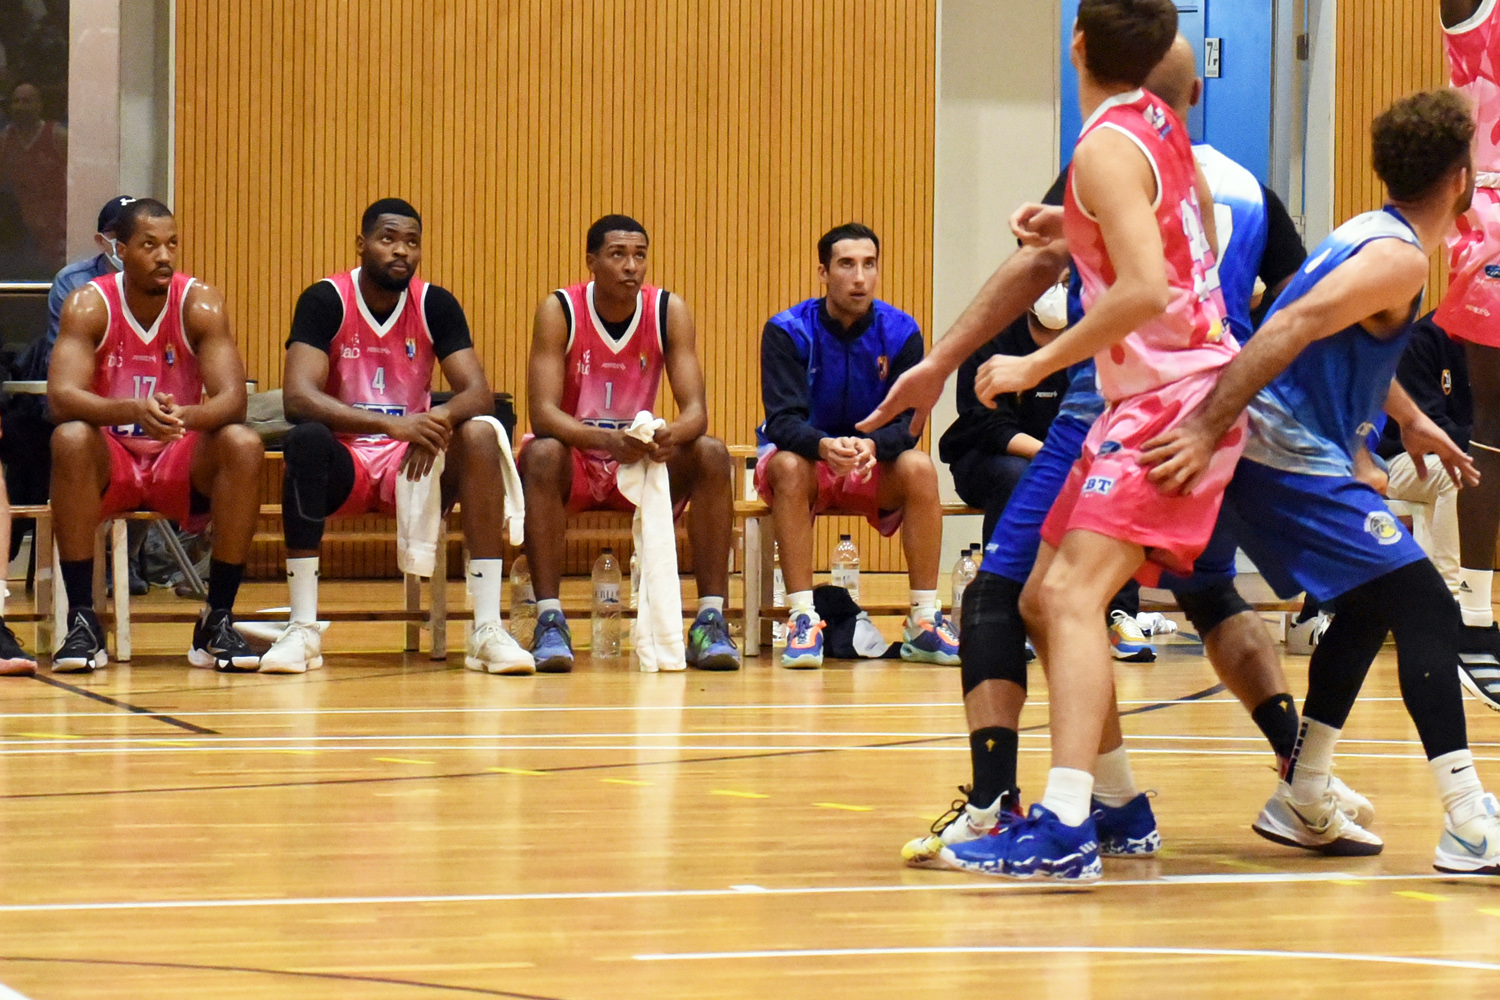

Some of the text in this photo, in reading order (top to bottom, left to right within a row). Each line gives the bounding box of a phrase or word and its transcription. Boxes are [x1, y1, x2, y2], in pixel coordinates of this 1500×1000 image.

[132, 375, 158, 399] 17
[371, 366, 386, 396] 4
[605, 381, 613, 410] 1
